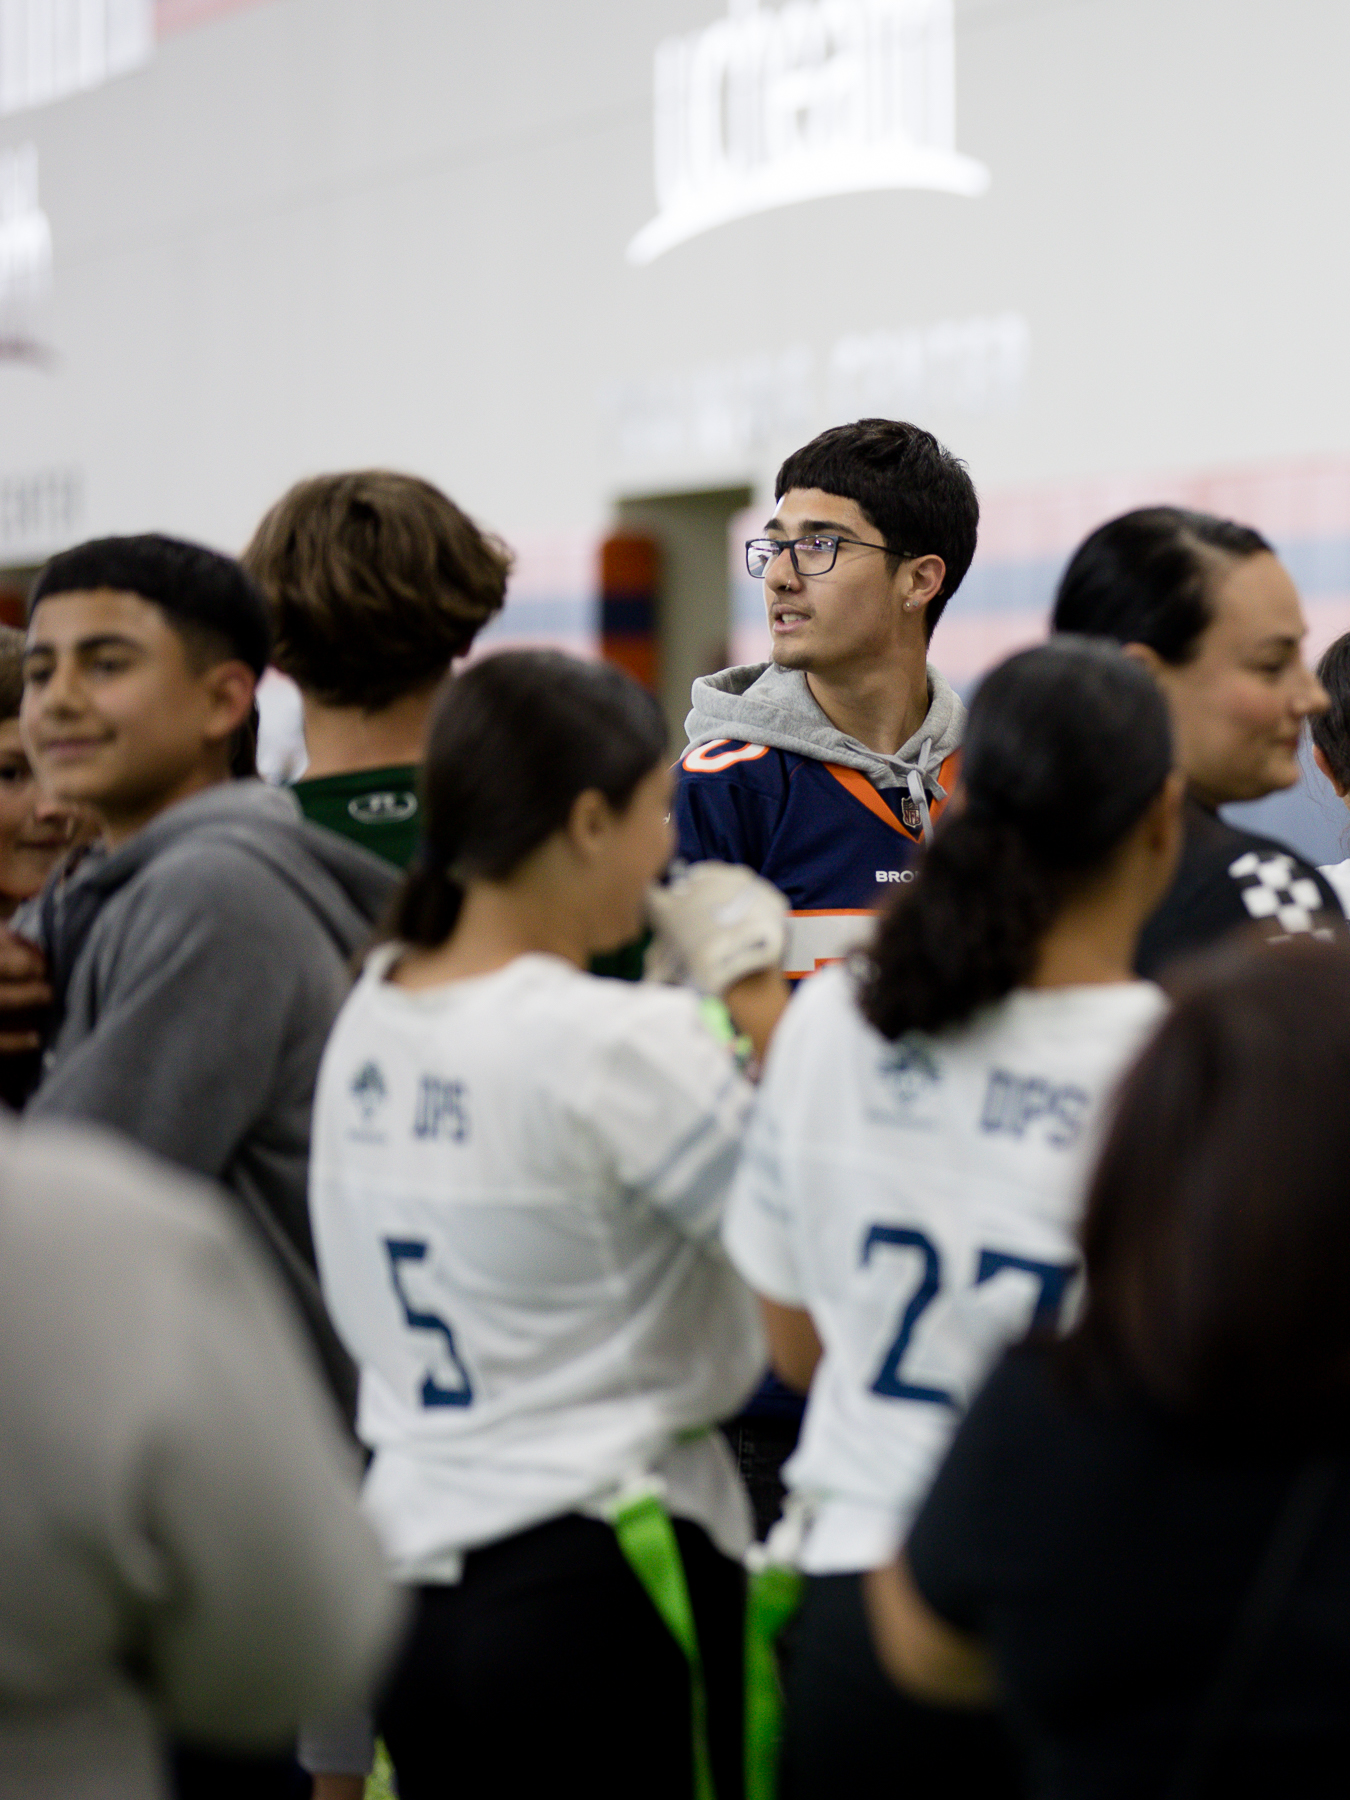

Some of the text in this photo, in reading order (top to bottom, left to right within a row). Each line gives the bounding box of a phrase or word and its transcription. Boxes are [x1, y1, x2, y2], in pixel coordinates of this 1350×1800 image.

[875, 869, 919, 883] BRO
[383, 1236, 474, 1410] 5
[860, 1223, 1083, 1406] 27
